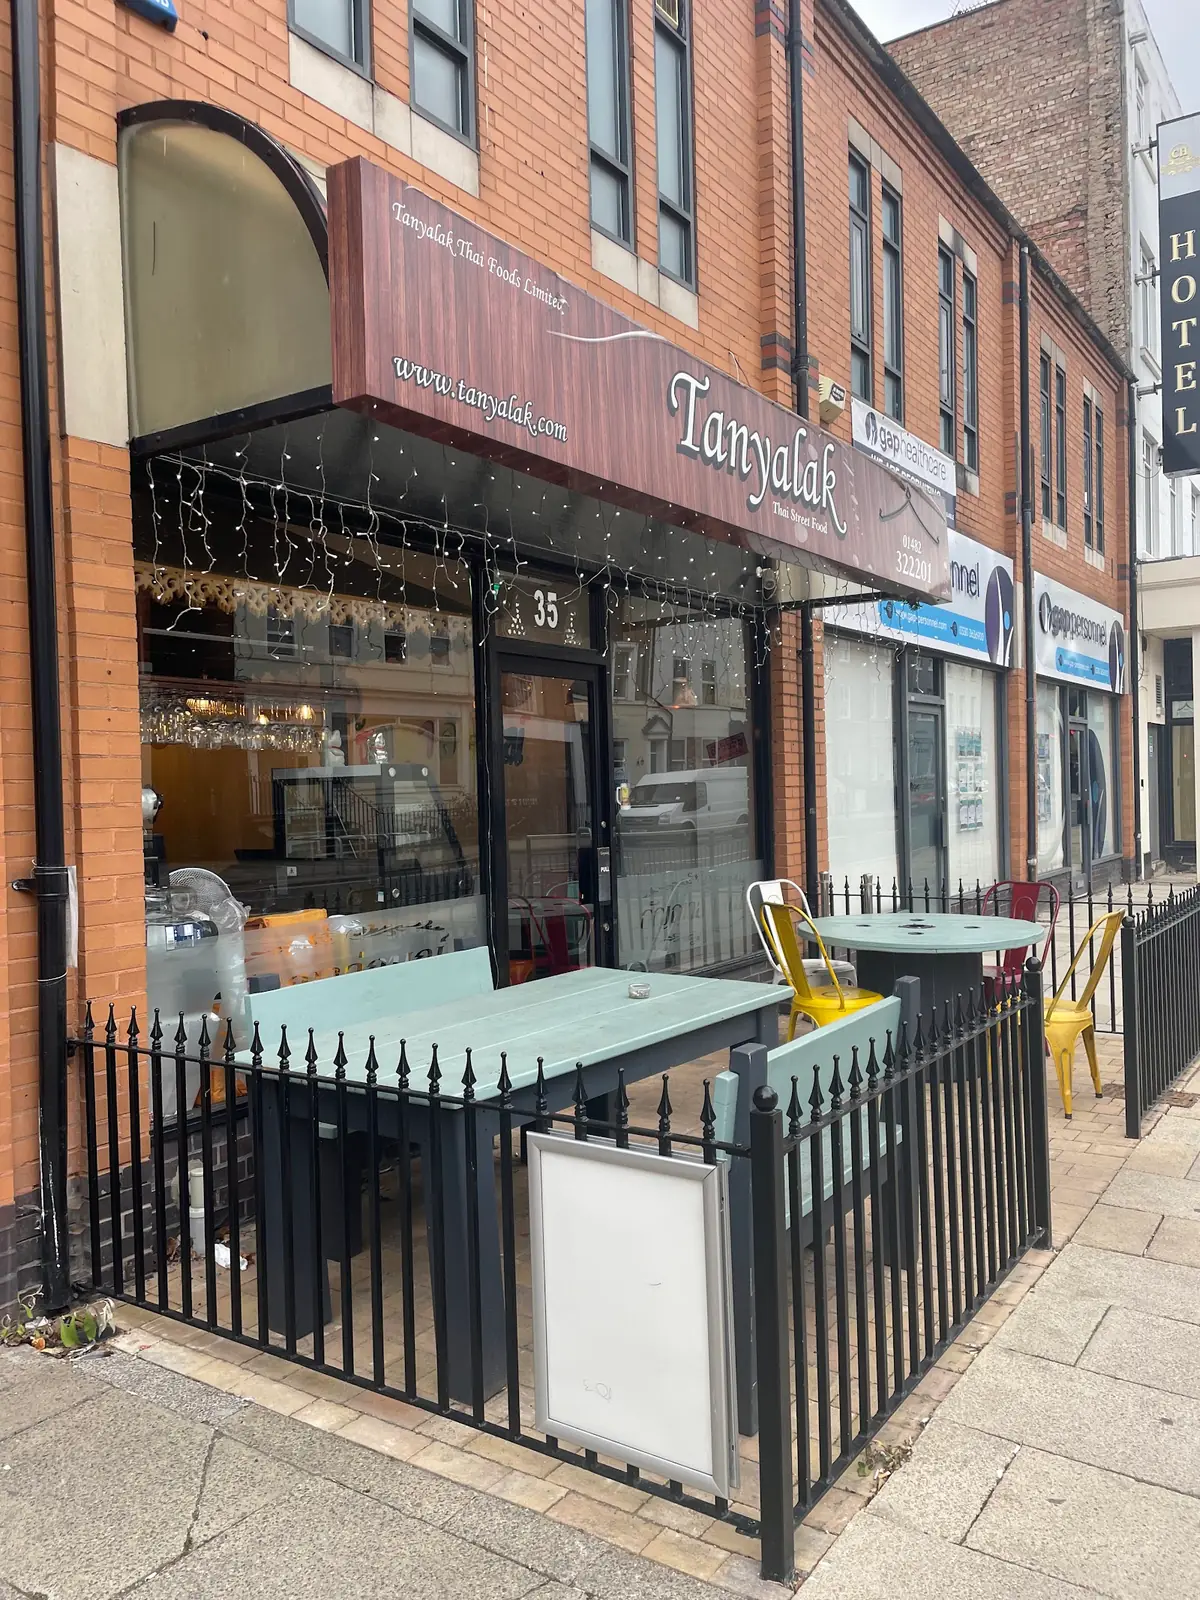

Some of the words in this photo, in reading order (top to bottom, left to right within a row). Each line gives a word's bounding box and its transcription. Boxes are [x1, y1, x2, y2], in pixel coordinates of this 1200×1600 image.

[391, 202, 457, 257] Tanyalak
[456, 238, 485, 268] Thai
[487, 257, 522, 288] Foods
[1168, 229, 1198, 437] HOTEL
[391, 356, 569, 442] www.tanyalak.com
[669, 371, 848, 536] Tanyalak
[772, 501, 790, 519] Thai
[790, 508, 811, 527] Street
[811, 516, 828, 534] Food
[902, 534, 922, 554] 01482
[895, 550, 932, 584] 322201
[533, 588, 559, 629] 35
